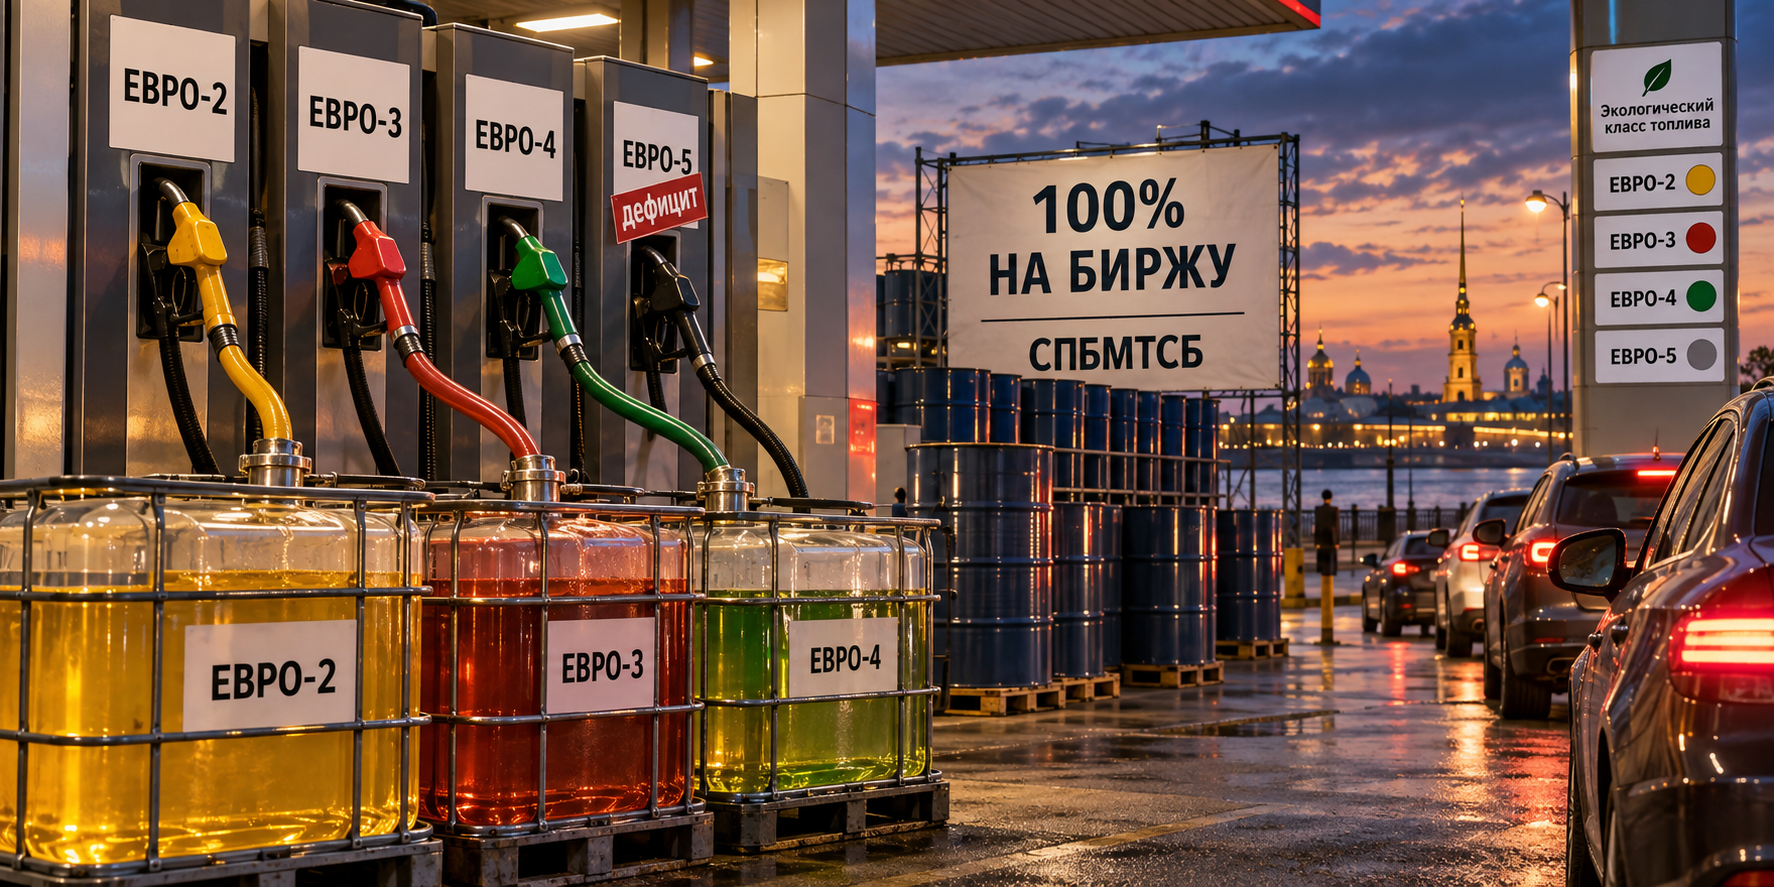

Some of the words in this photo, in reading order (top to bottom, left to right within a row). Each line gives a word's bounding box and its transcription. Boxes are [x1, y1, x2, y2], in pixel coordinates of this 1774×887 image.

[124, 67, 228, 116] ЕВРО-2
[1600, 97, 1714, 118] Экологический
[309, 95, 402, 139] ЕВРО-3
[1604, 121, 1647, 135] класс
[1649, 118, 1711, 132] топлива
[475, 119, 557, 159] ЕВРО-4
[623, 139, 692, 175] ЕВРО-5
[1609, 173, 1676, 194] ЕВРО-2
[622, 186, 698, 232] дефицит
[1032, 177, 1185, 234] 100%
[1610, 231, 1676, 251] ЕВРО-3
[989, 251, 1052, 296] НА
[1070, 243, 1237, 293] БИРЖУ
[1610, 288, 1677, 308] ЕВРО-4
[1029, 334, 1204, 372] СПБМТСБ
[1611, 347, 1677, 366] ЕВРО-5
[561, 648, 644, 684] ЕВРО-3
[810, 644, 882, 674] ЕВРО-4
[211, 658, 336, 701] ЕВРО-2
